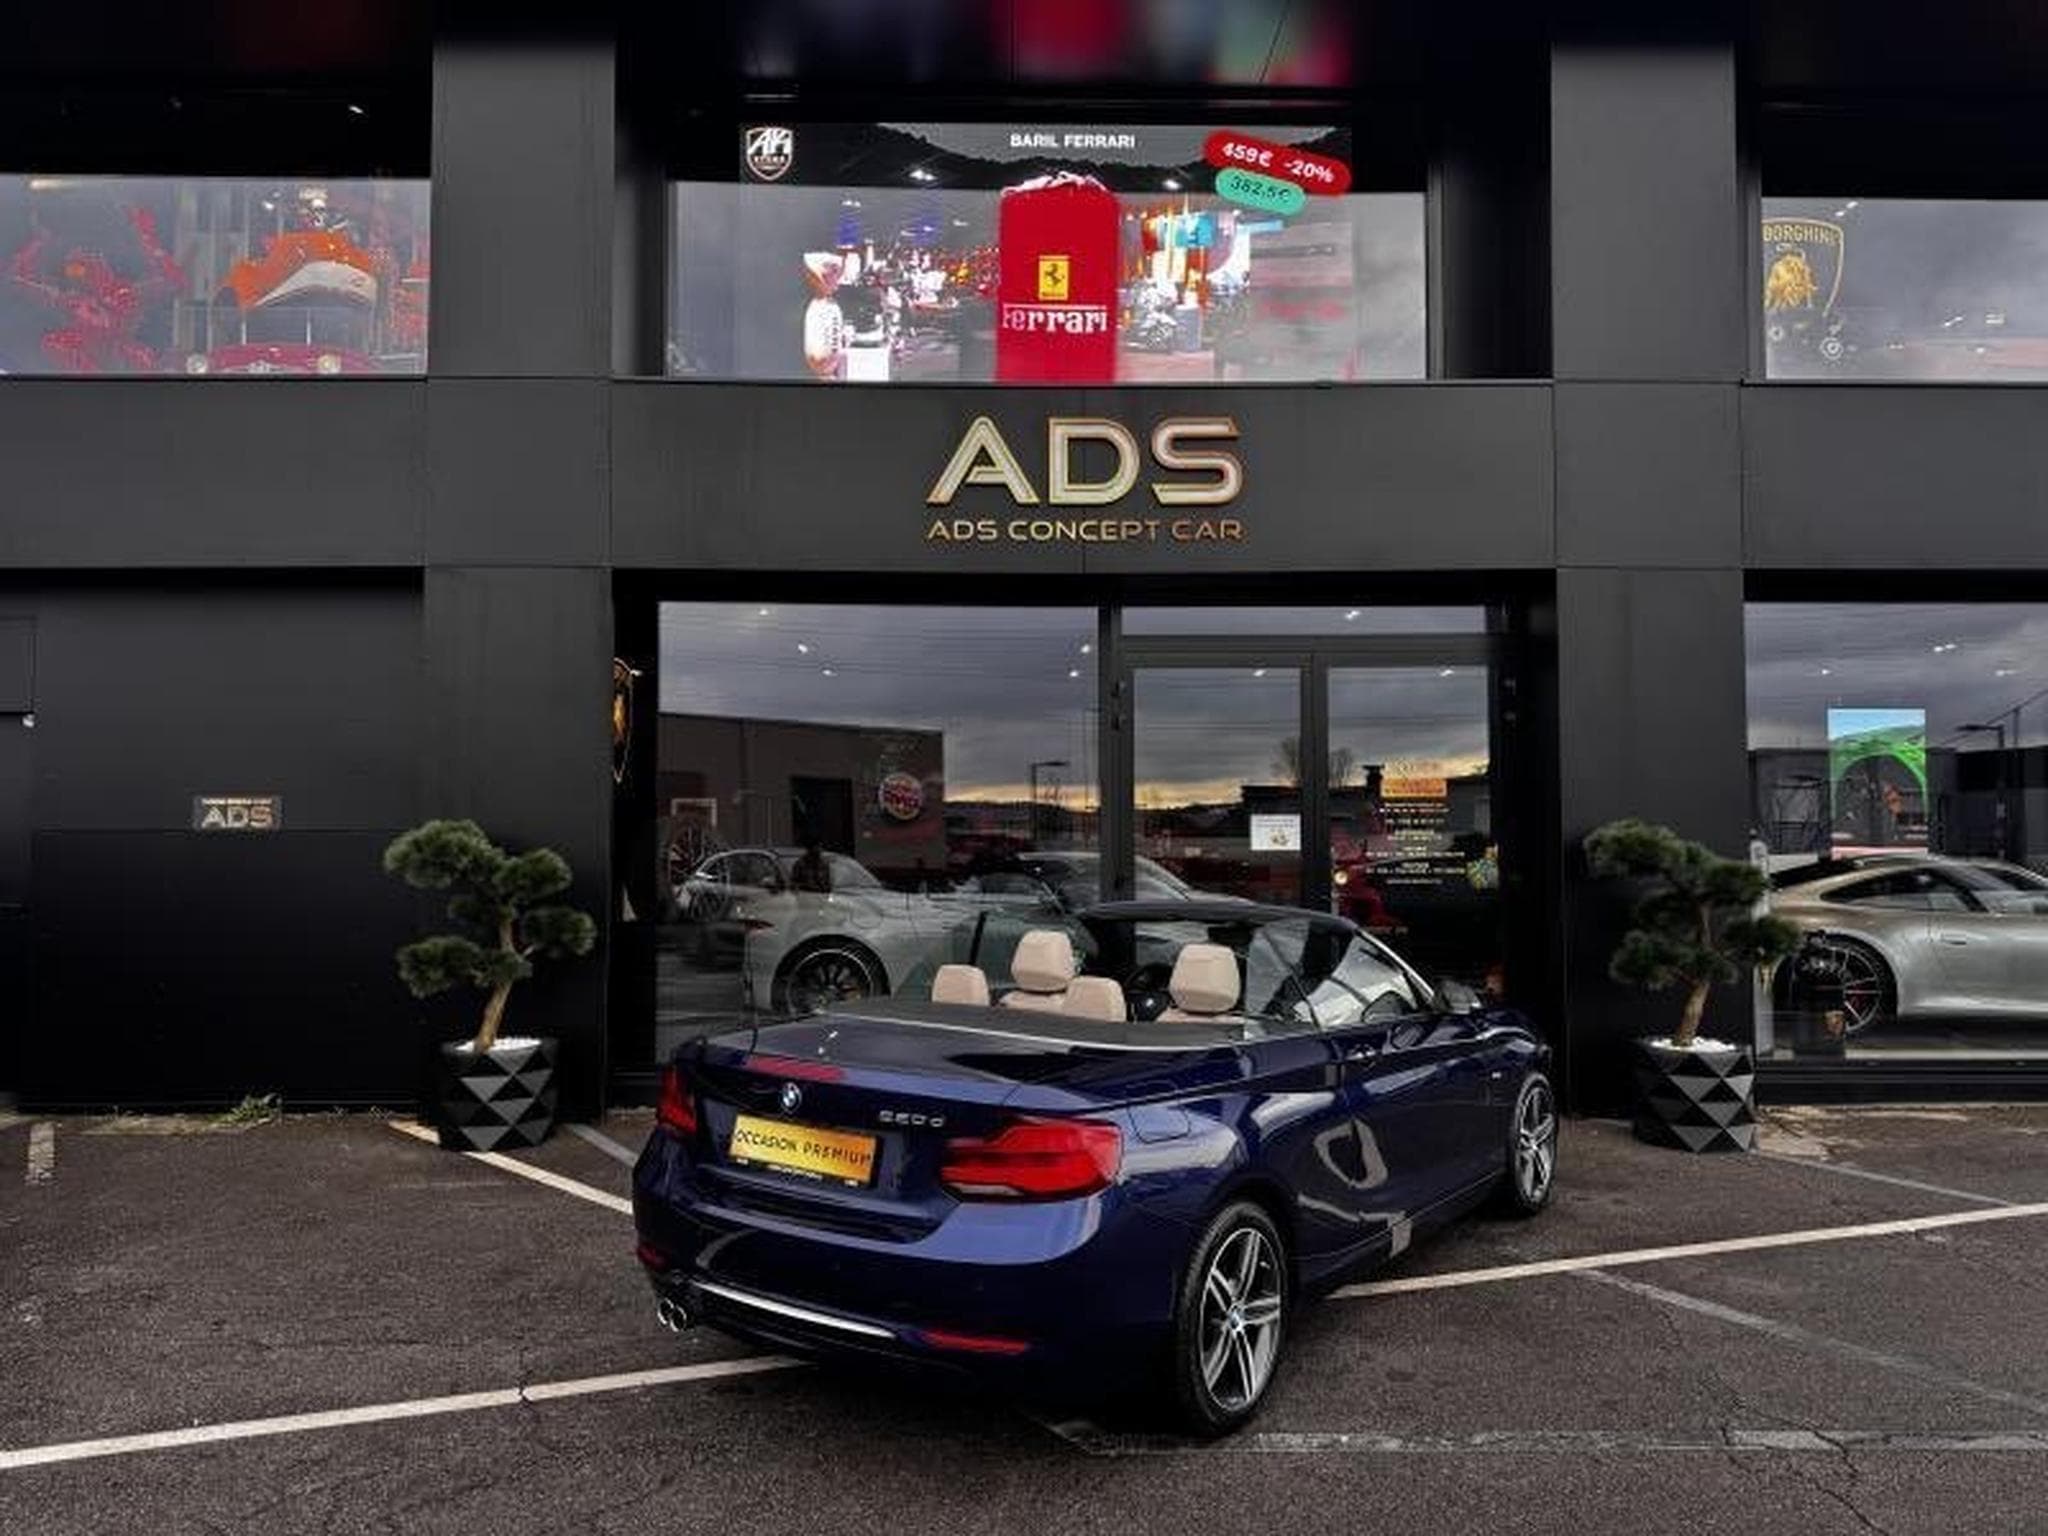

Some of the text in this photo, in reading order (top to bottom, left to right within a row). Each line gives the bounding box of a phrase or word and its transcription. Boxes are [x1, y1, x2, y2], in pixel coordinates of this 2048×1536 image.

[1009, 133, 1136, 149] BARIL FERRARI
[1222, 142, 1335, 183] 459€ -20%
[927, 416, 1243, 505] ADS
[928, 520, 1243, 542] ADS CONCEPT CAR
[201, 804, 273, 829] ADS
[735, 1129, 798, 1153] OCCASION
